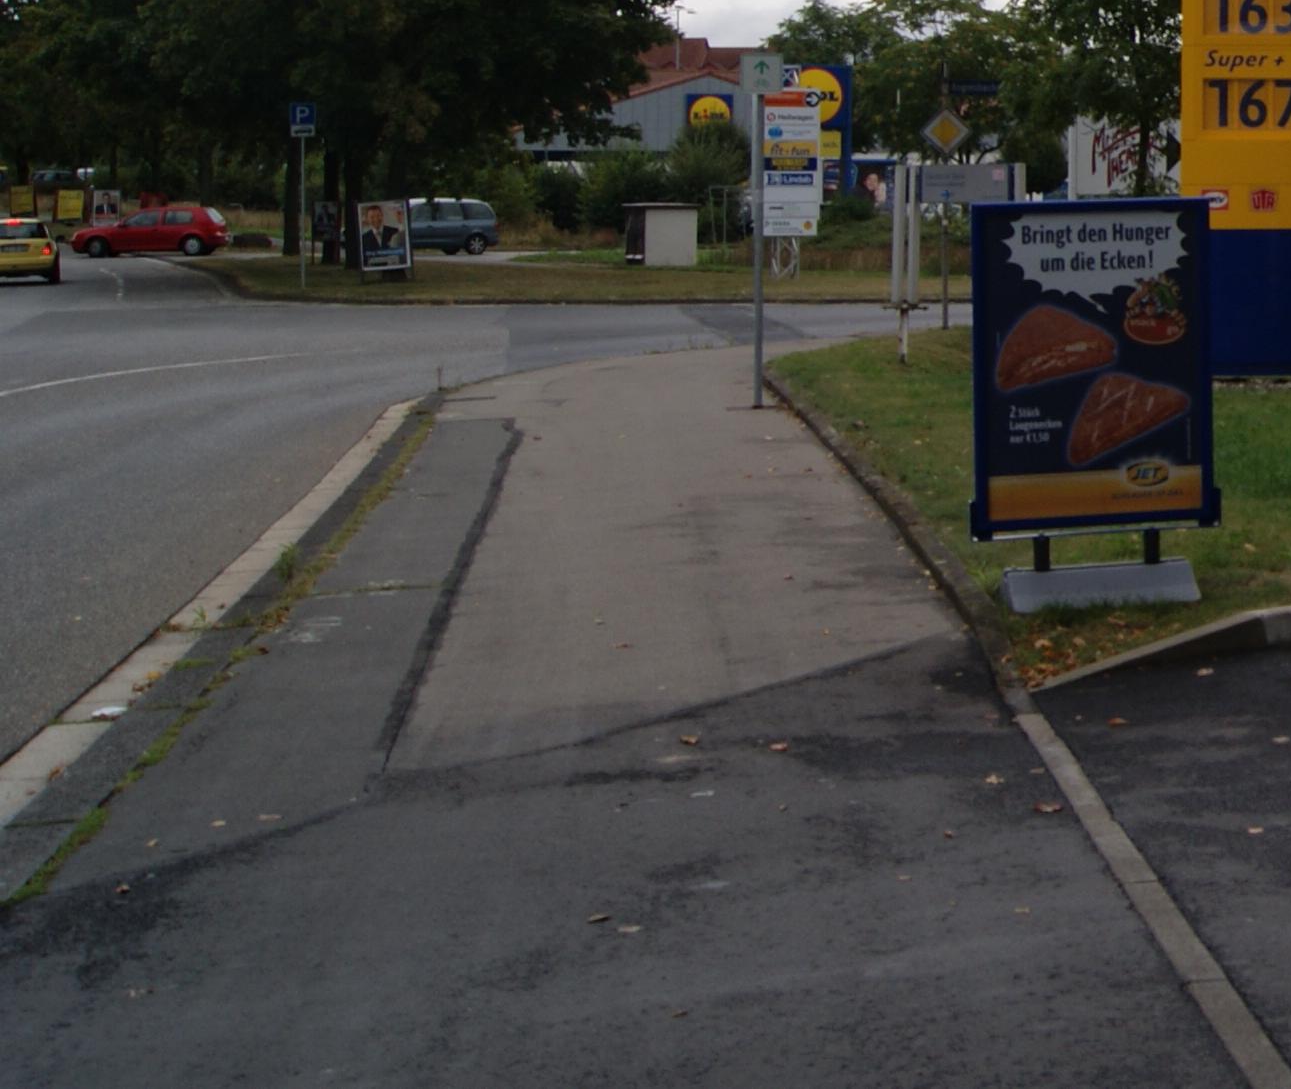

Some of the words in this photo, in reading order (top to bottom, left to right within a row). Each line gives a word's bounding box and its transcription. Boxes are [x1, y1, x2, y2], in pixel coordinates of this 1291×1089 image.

[1204, 49, 1269, 72] Super
[1273, 55, 1286, 67] +
[296, 106, 310, 124] P
[1021, 224, 1073, 249] Bringt
[1077, 221, 1108, 244] den
[1112, 222, 1172, 246] Hunger
[1040, 257, 1066, 272] um
[1070, 251, 1096, 272] die
[1009, 404, 1017, 419] 2
[1009, 434, 1025, 444] nur
[1131, 467, 1163, 481] JET
